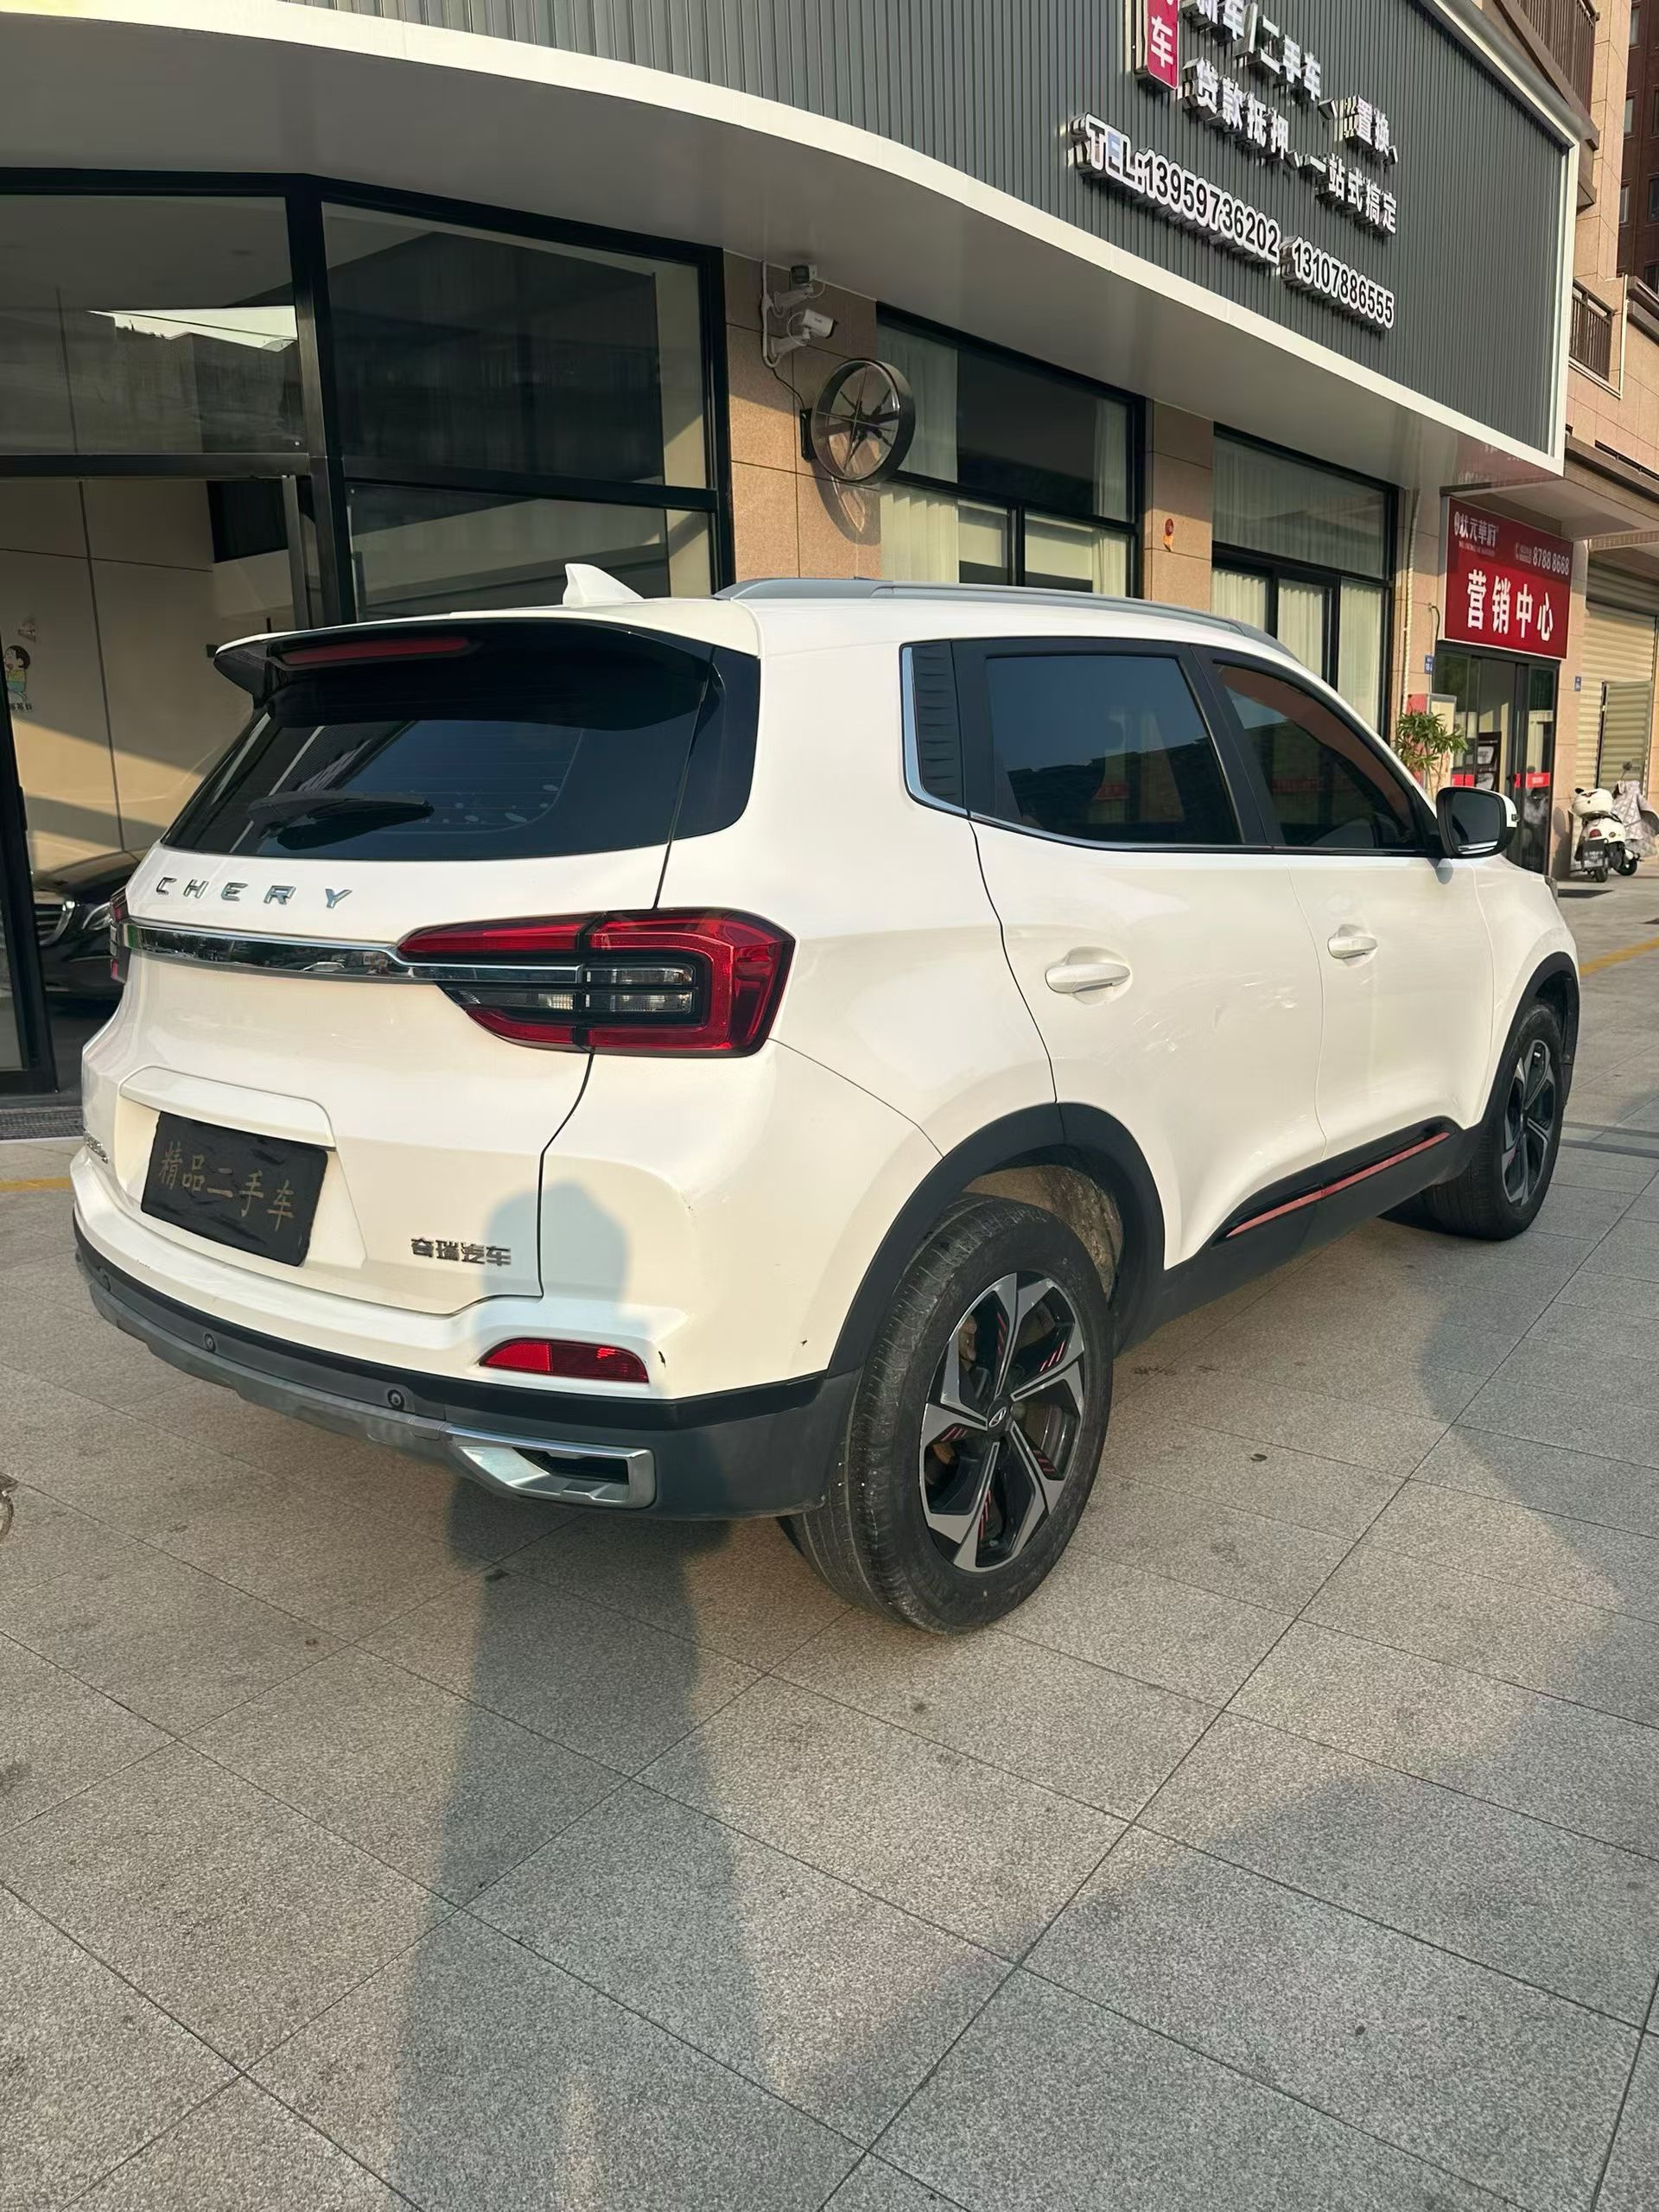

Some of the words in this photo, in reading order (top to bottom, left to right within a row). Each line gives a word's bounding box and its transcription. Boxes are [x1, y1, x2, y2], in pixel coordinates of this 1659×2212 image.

[1292, 236, 1395, 329] 13107886555
[1467, 569, 1554, 642] 营销中心
[156, 875, 353, 910] CHERY
[158, 1140, 296, 1232] 精品二手车
[410, 1236, 512, 1268] 奇瑞汽车
